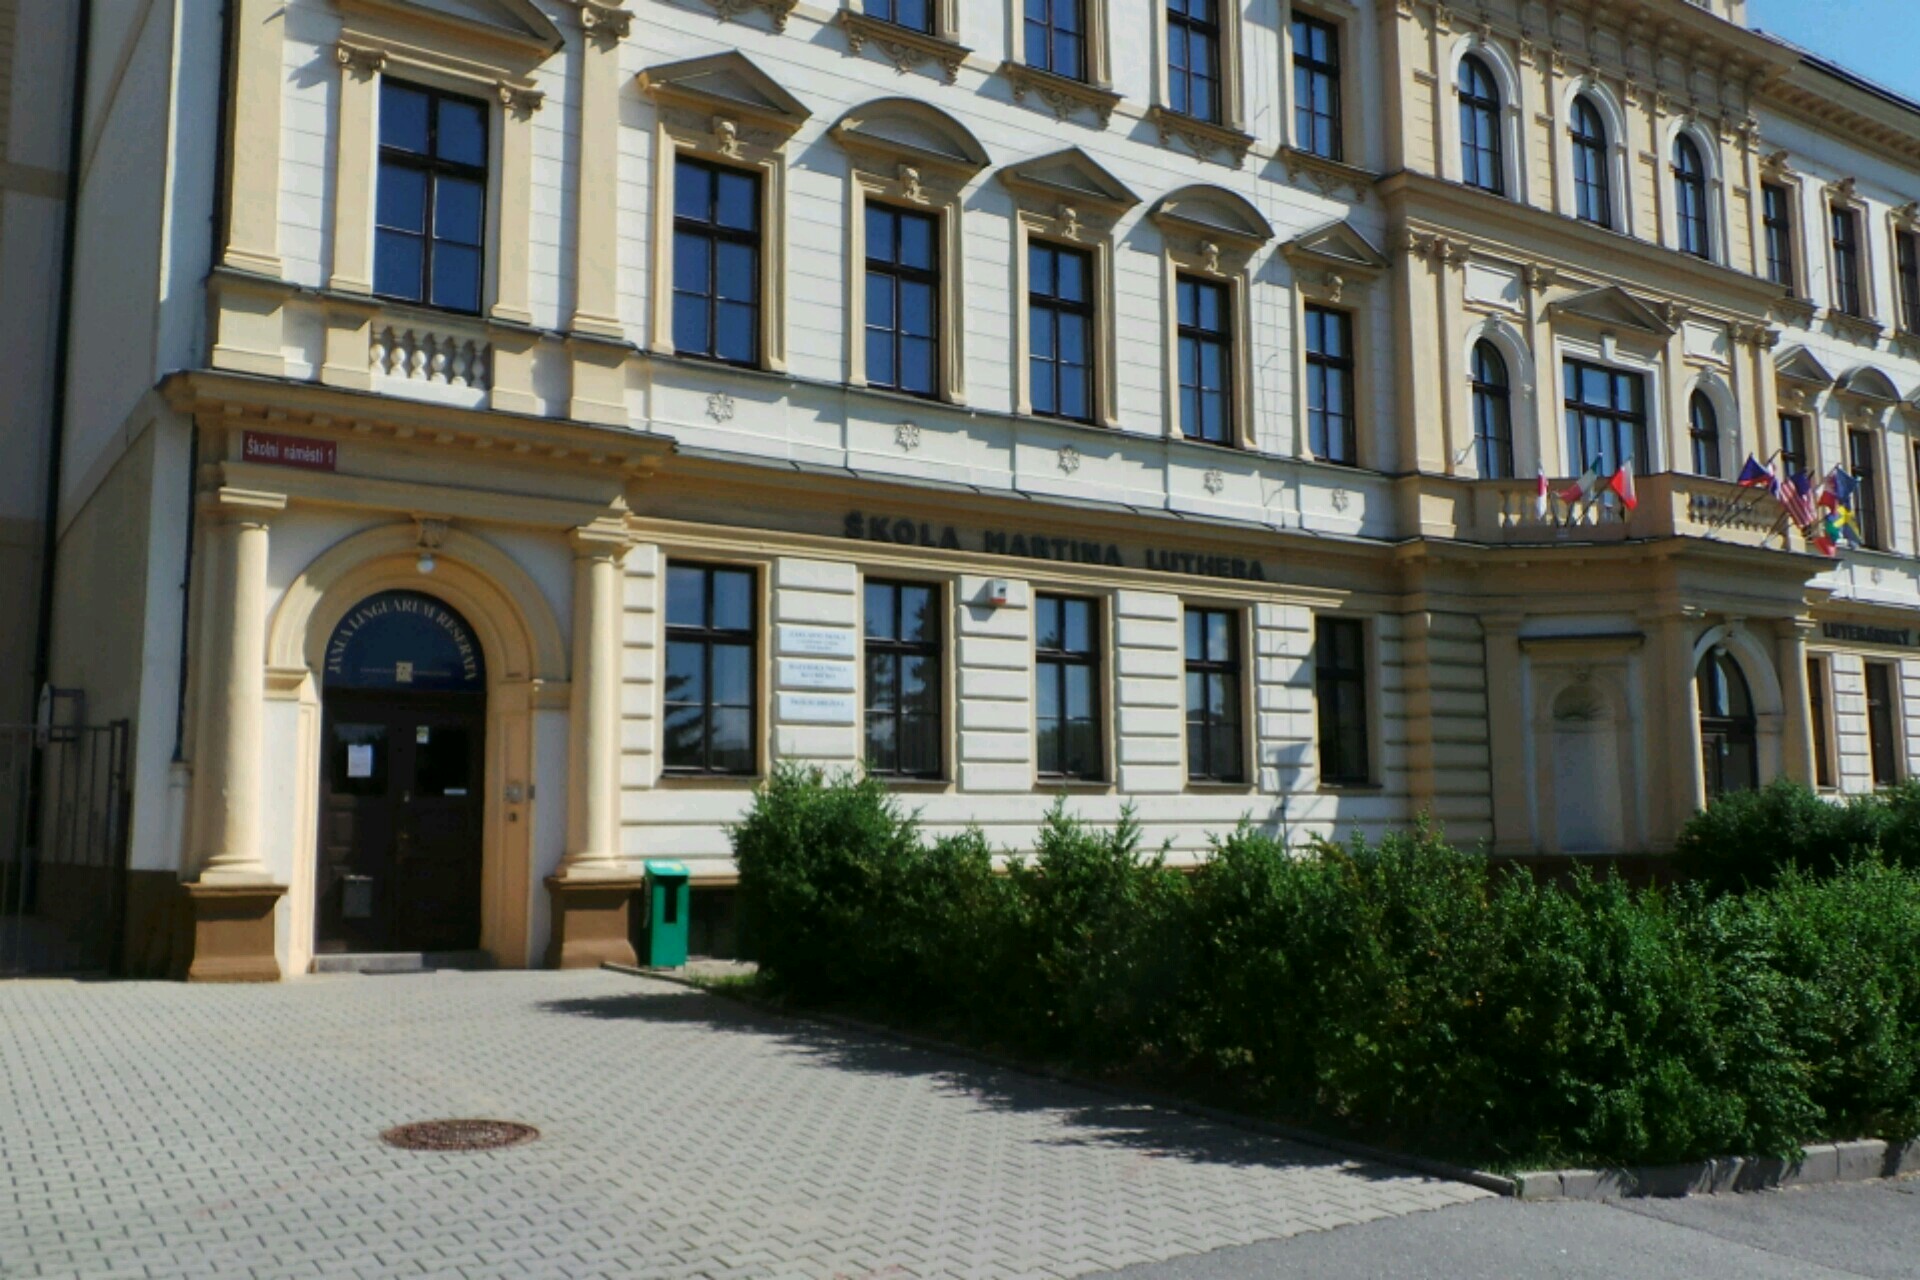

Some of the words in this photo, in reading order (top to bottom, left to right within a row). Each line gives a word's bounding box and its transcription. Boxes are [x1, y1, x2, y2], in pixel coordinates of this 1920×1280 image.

[246, 433, 279, 458] Školní
[284, 444, 324, 464] náměstí
[328, 448, 334, 464] 1
[844, 510, 961, 550] ŠKOLA
[984, 529, 1123, 567] MARTINA
[1146, 548, 1265, 581] LUTHERA
